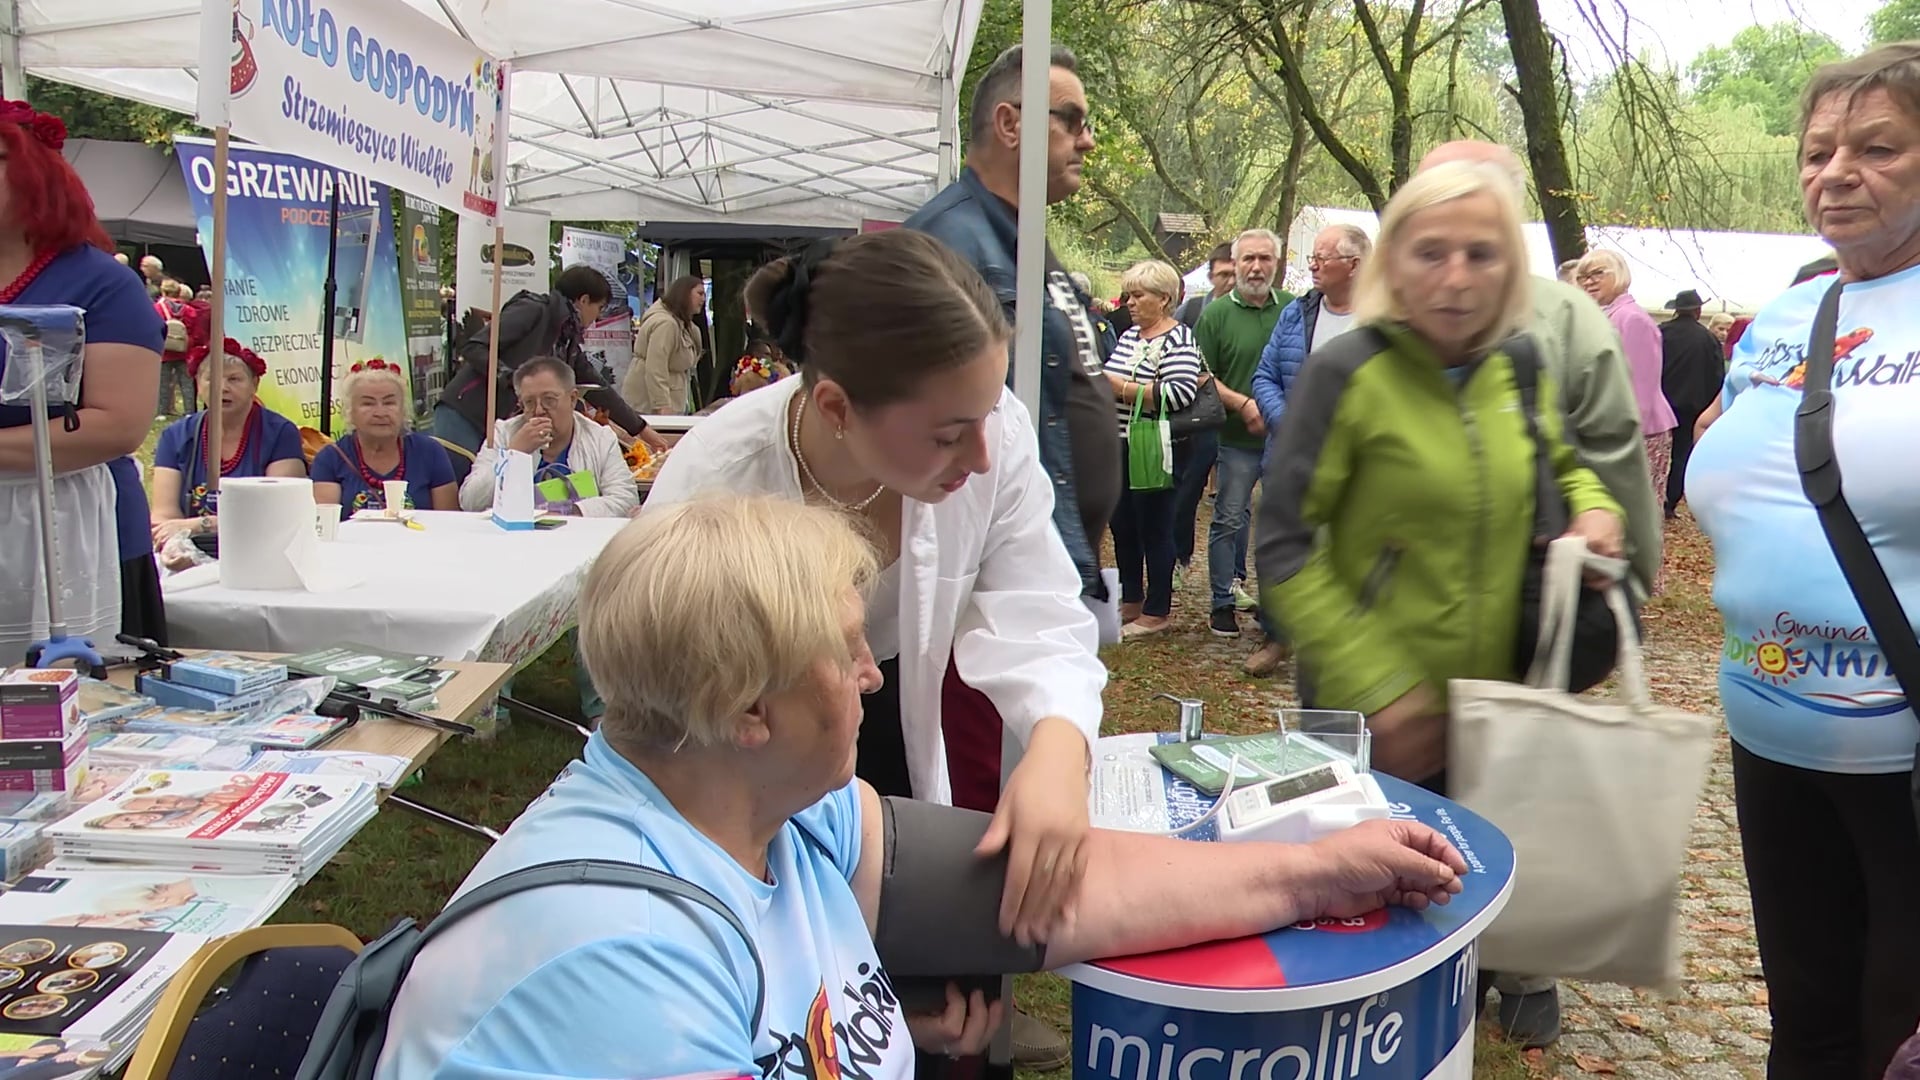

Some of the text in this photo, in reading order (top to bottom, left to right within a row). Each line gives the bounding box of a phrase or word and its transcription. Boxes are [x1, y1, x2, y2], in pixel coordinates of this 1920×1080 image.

[262, 0, 475, 137] KOŁO GOSPODYŃ
[282, 75, 454, 189] Strzemieszyce Wielkie
[190, 156, 380, 207] OGRZEWANIE
[224, 278, 257, 297] TANIE
[236, 305, 290, 323] ZDROWE
[252, 334, 321, 353] BEZPIECZNE
[1775, 611, 1870, 642] Gmina
[1463, 848, 1486, 869] partner
